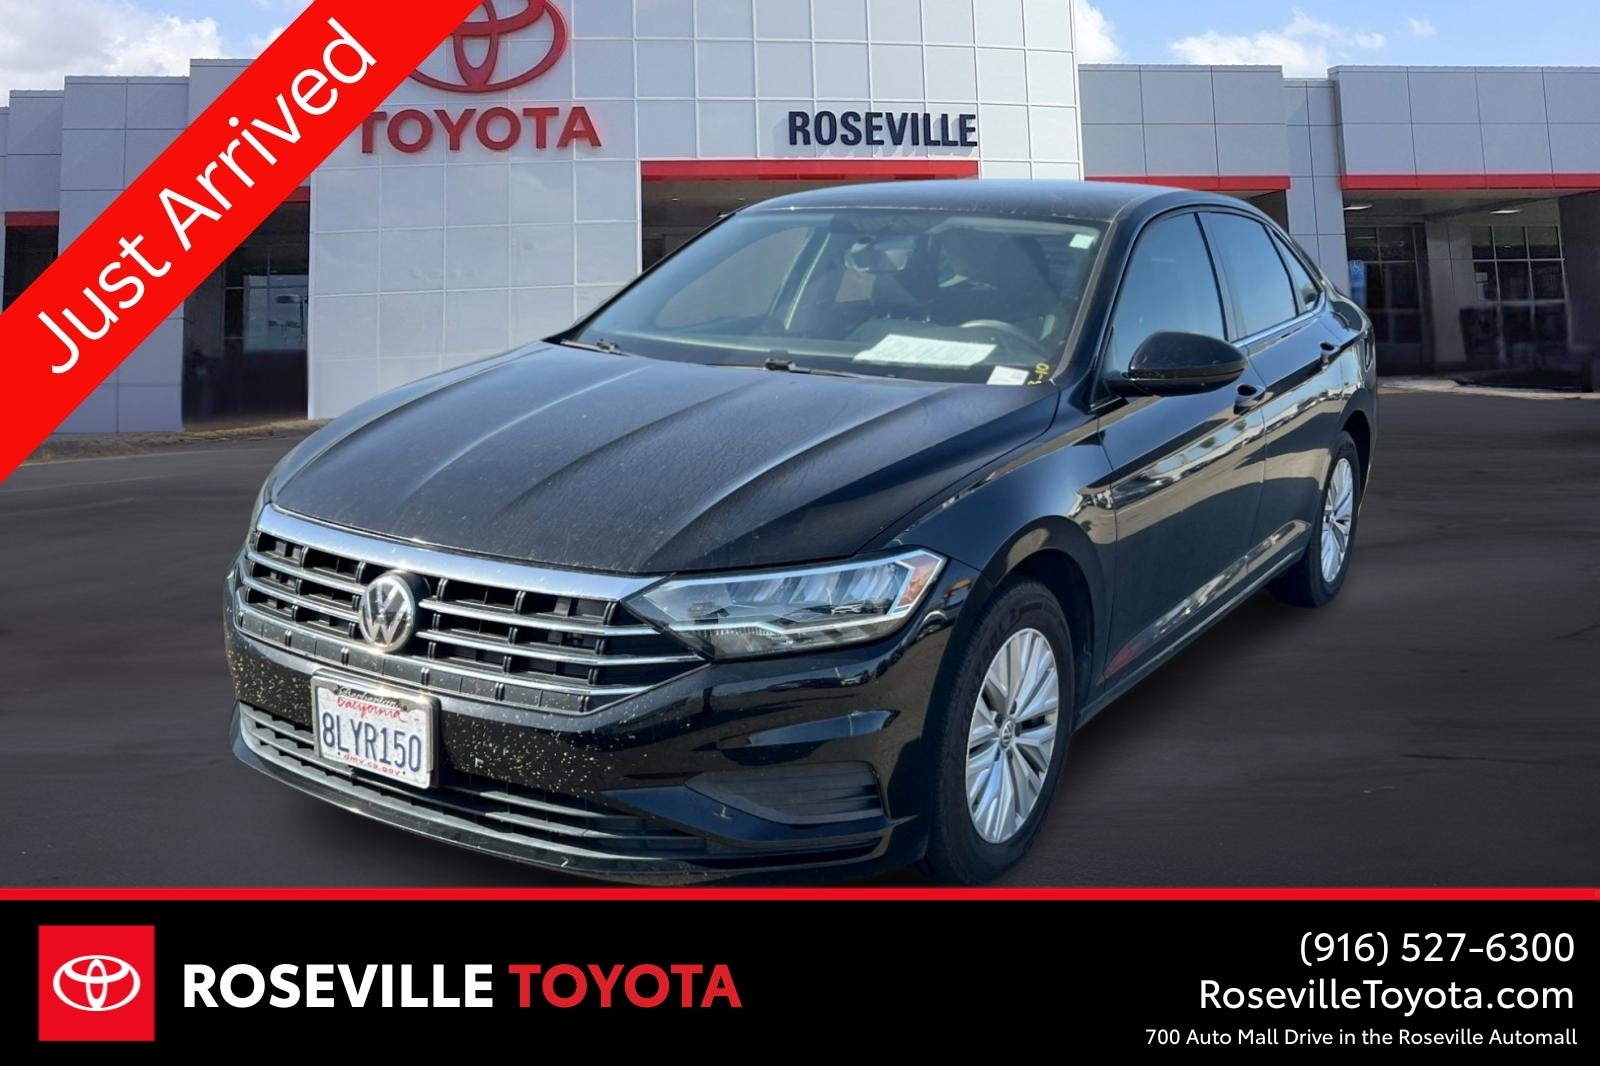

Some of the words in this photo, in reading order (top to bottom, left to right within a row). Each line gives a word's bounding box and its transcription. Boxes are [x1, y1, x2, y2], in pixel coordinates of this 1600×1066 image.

[360, 106, 601, 154] TOYOTA
[788, 110, 978, 148] ROSEVILLE
[323, 712, 421, 773] 8LYR150
